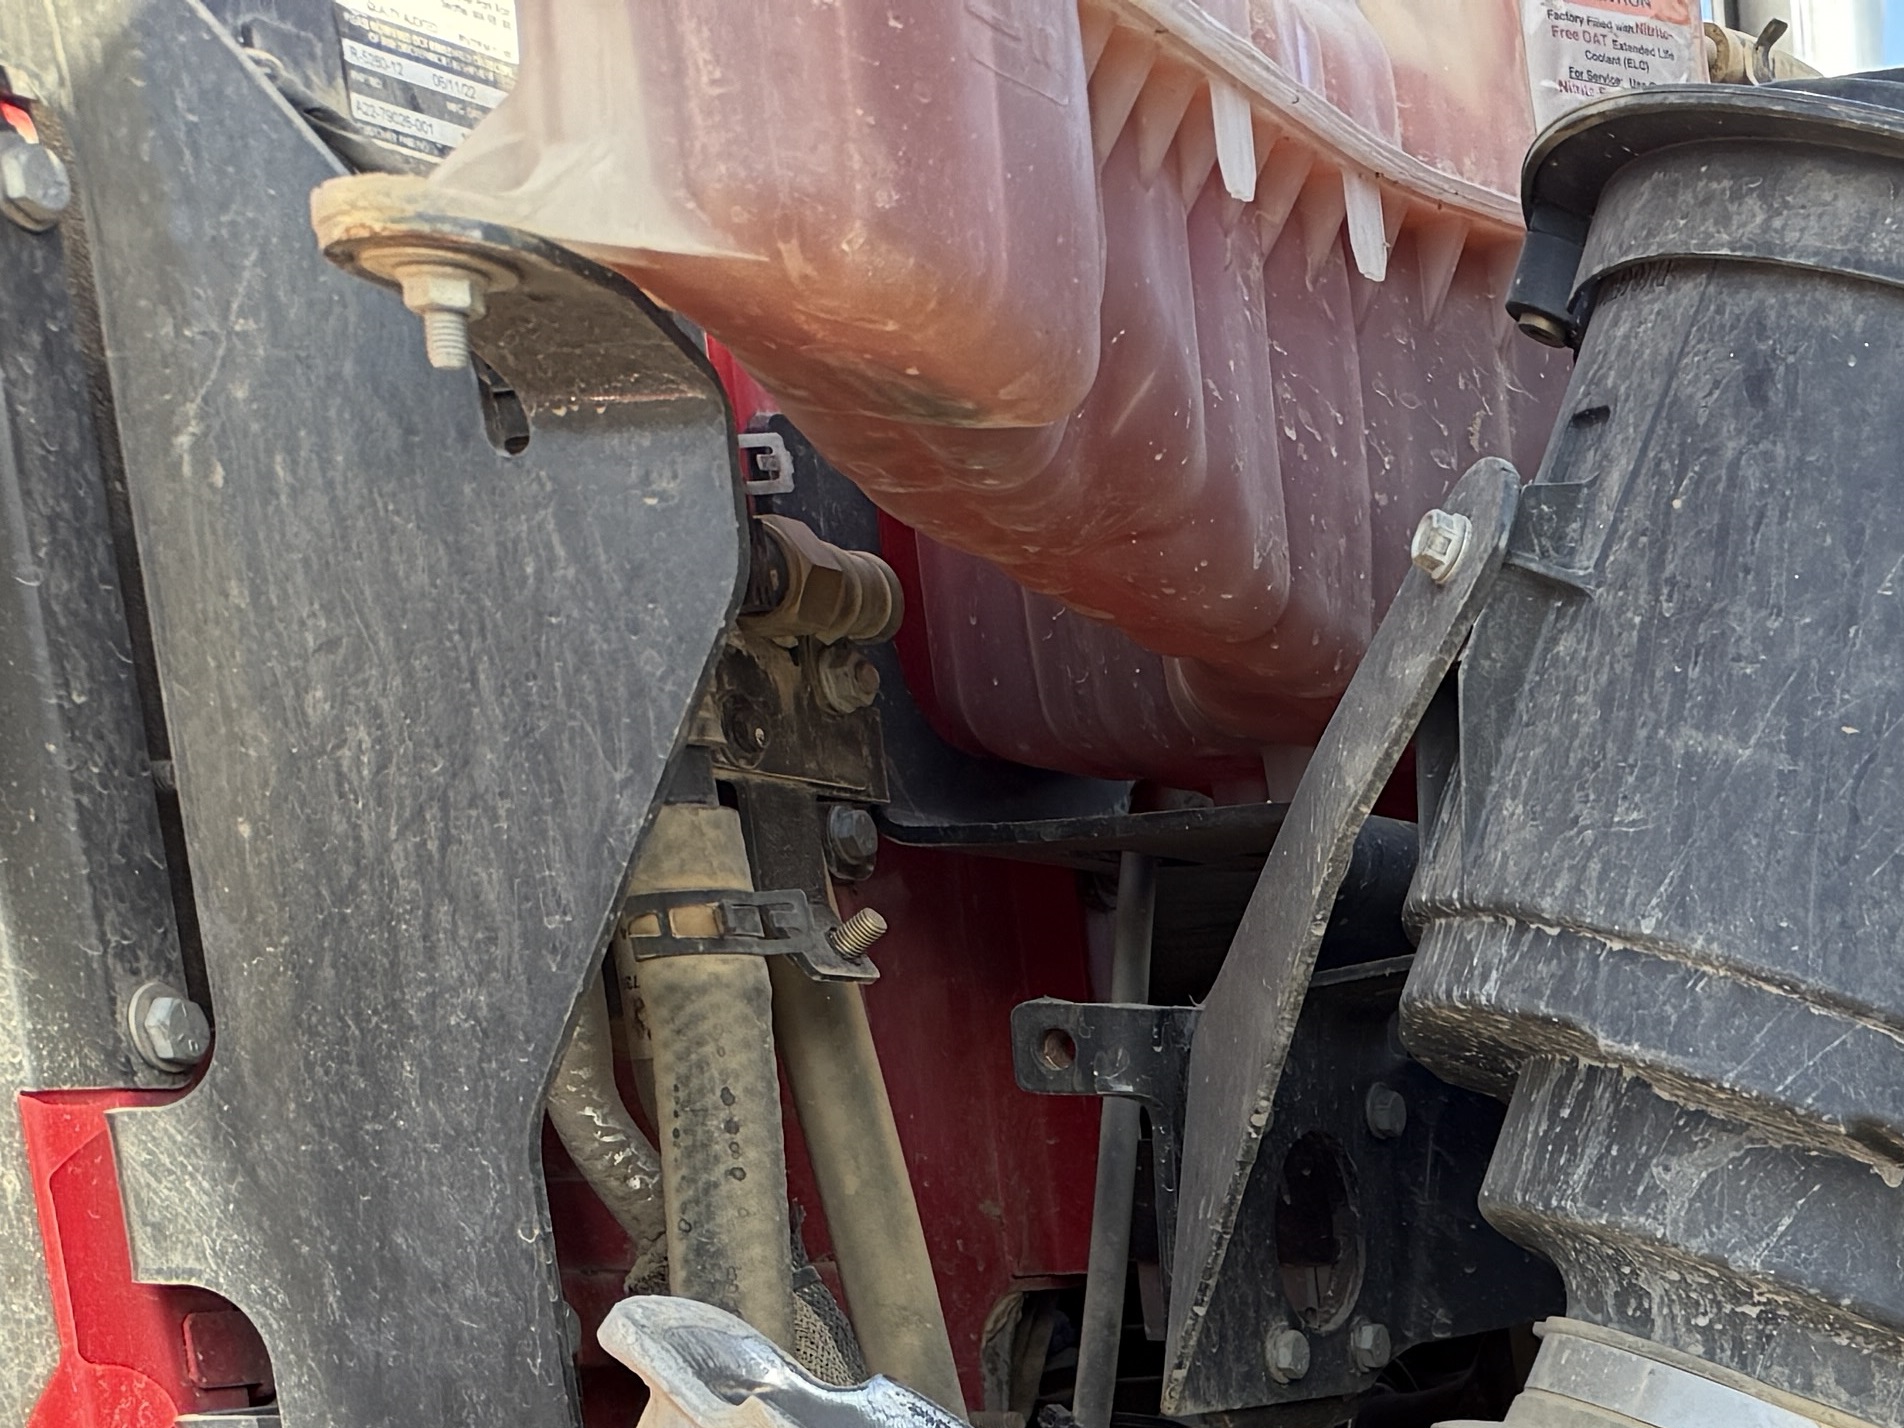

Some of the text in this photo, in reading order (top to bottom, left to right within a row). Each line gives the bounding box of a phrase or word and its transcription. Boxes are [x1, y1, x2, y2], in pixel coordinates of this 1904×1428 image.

[1547, 9, 1584, 27] Factory
[1551, 25, 1675, 61] Free OAT Extended Life
[1585, 50, 1649, 74] Coolant (ELC)
[1569, 67, 1583, 79] For
